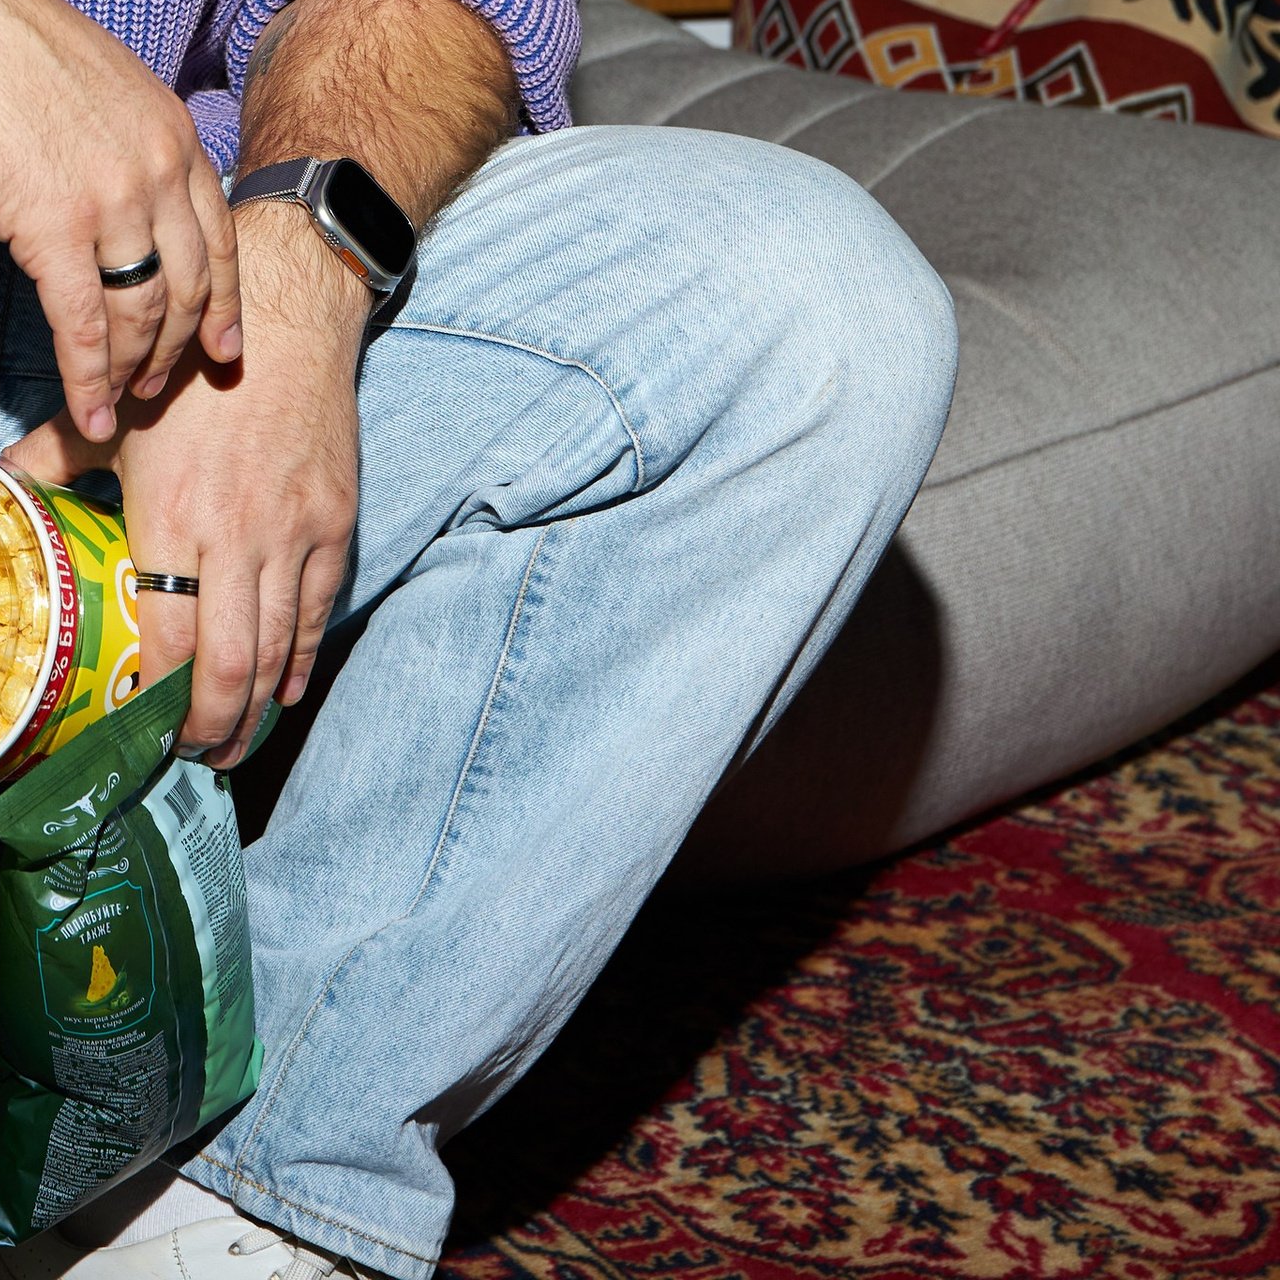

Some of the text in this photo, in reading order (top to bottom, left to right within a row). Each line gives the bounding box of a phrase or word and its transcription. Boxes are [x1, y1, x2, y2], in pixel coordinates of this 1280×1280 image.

[60, 903, 122, 940] ПОПРОБУЙТЕ
[79, 921, 112, 945] ТАКЖЕ
[63, 996, 146, 1025] вкус перца халапеньо
[95, 1018, 123, 1030] и сыра
